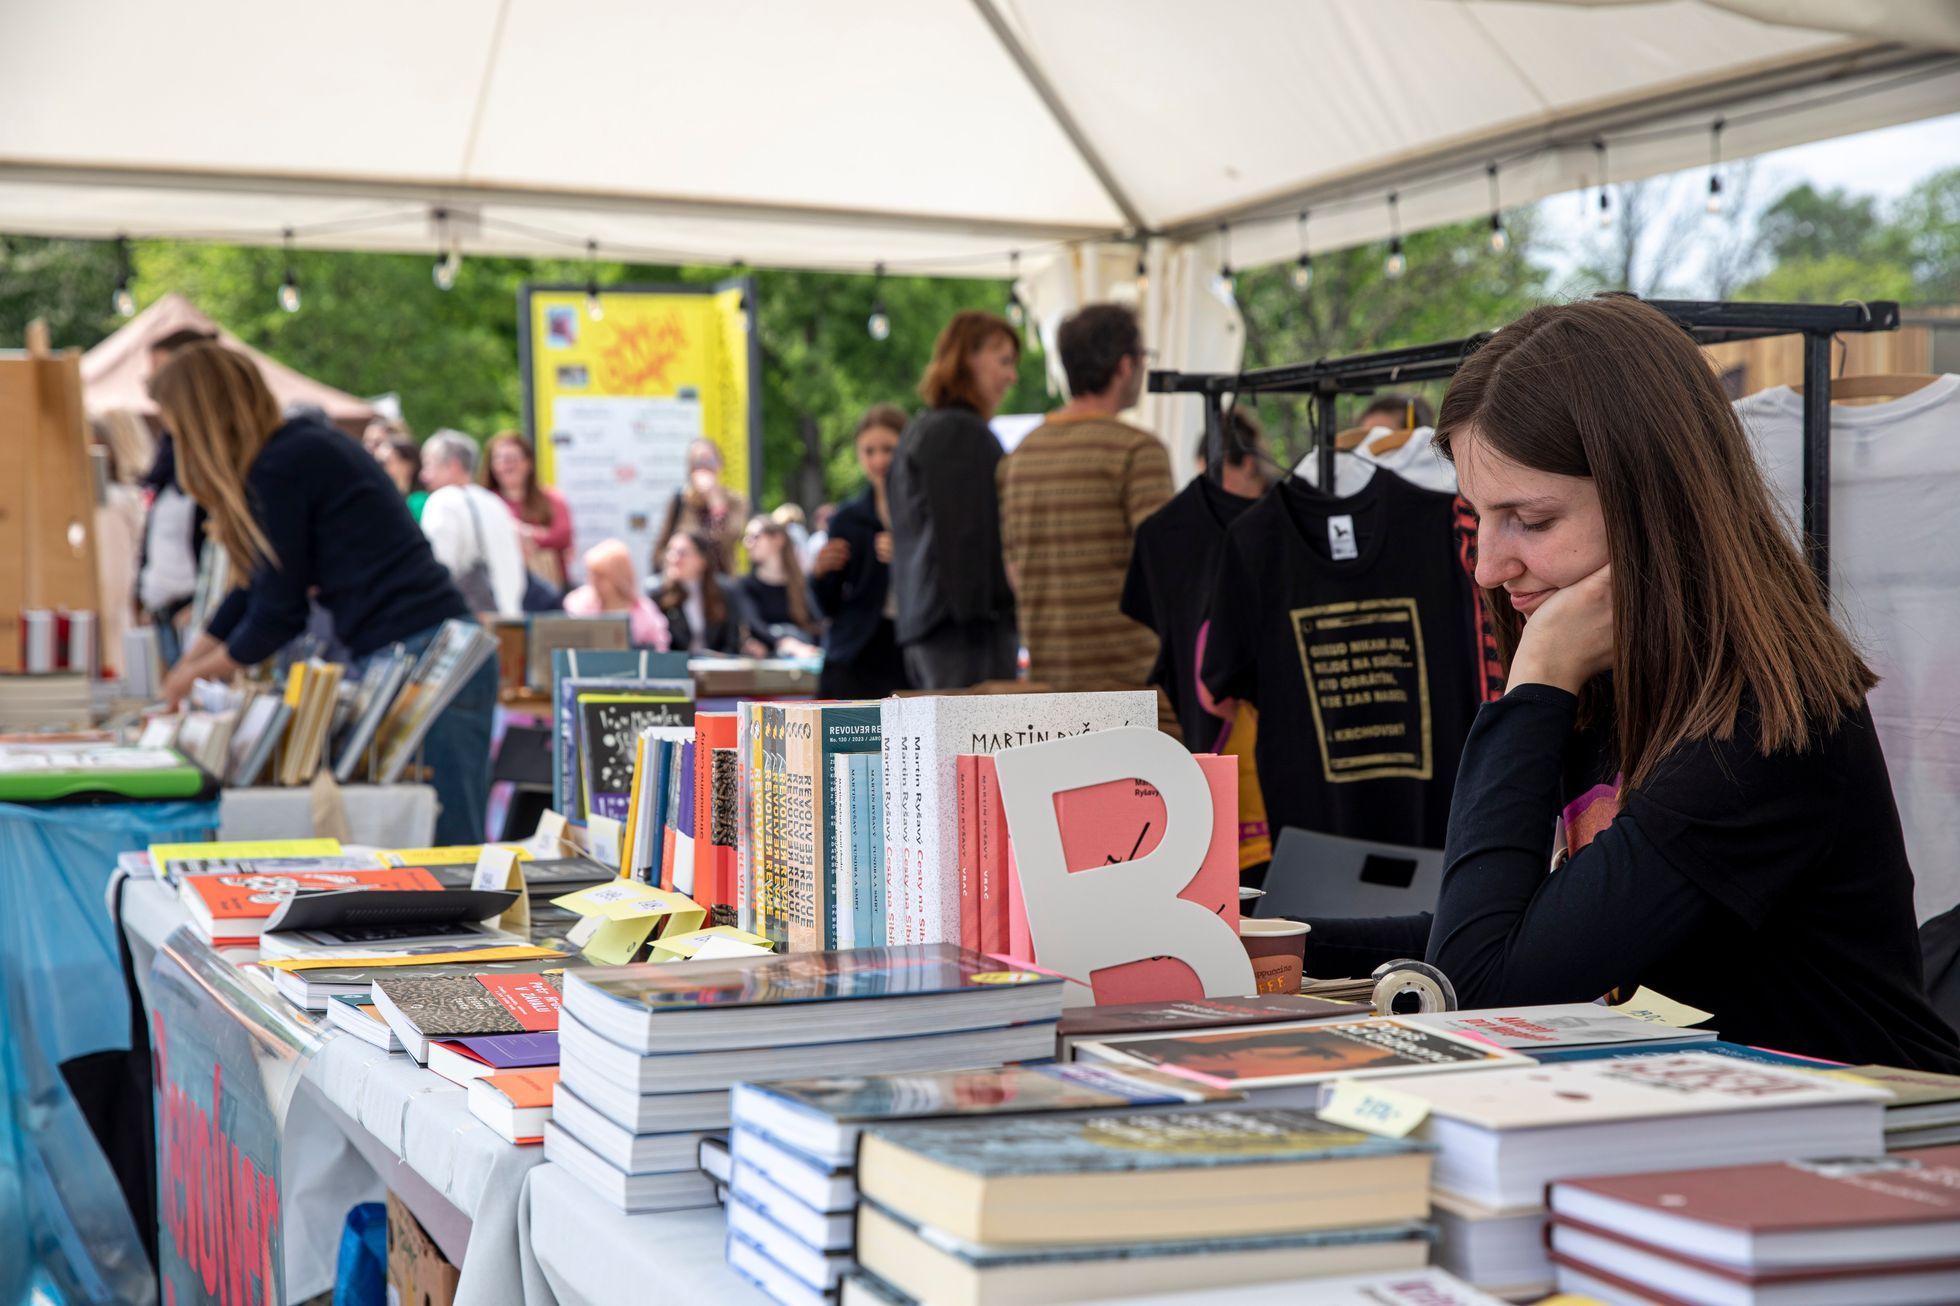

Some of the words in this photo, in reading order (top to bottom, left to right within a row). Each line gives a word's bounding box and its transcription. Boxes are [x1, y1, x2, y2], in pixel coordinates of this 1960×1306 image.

[805, 870, 814, 929] REVUE
[887, 890, 892, 907] na
[904, 892, 910, 910] na
[918, 895, 924, 913] na
